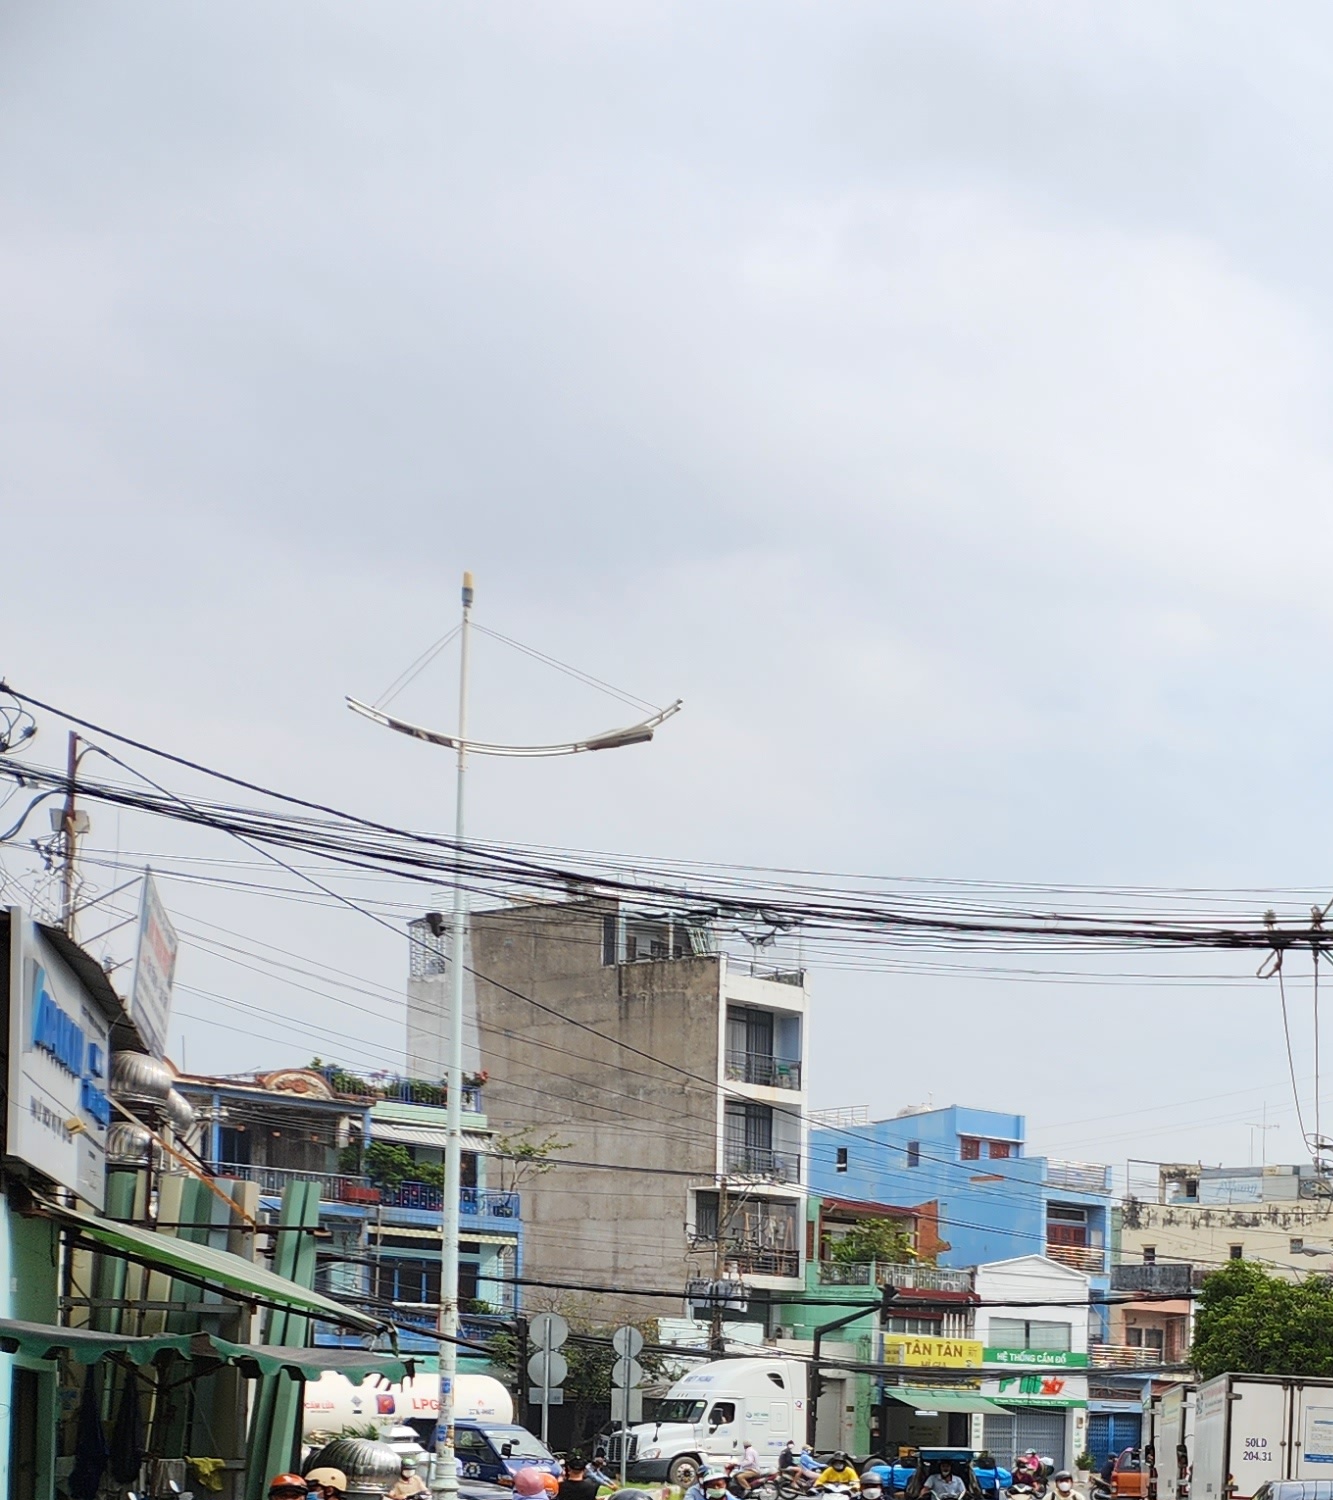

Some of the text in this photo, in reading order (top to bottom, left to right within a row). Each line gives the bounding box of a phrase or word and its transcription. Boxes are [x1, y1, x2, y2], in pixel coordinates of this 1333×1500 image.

[905, 1339, 932, 1356] TÂN
[936, 1341, 963, 1358] TÂN
[412, 1398, 441, 1411] LPG
[1245, 1437, 1267, 1448] 50LD
[1242, 1450, 1272, 1461] 204.31
